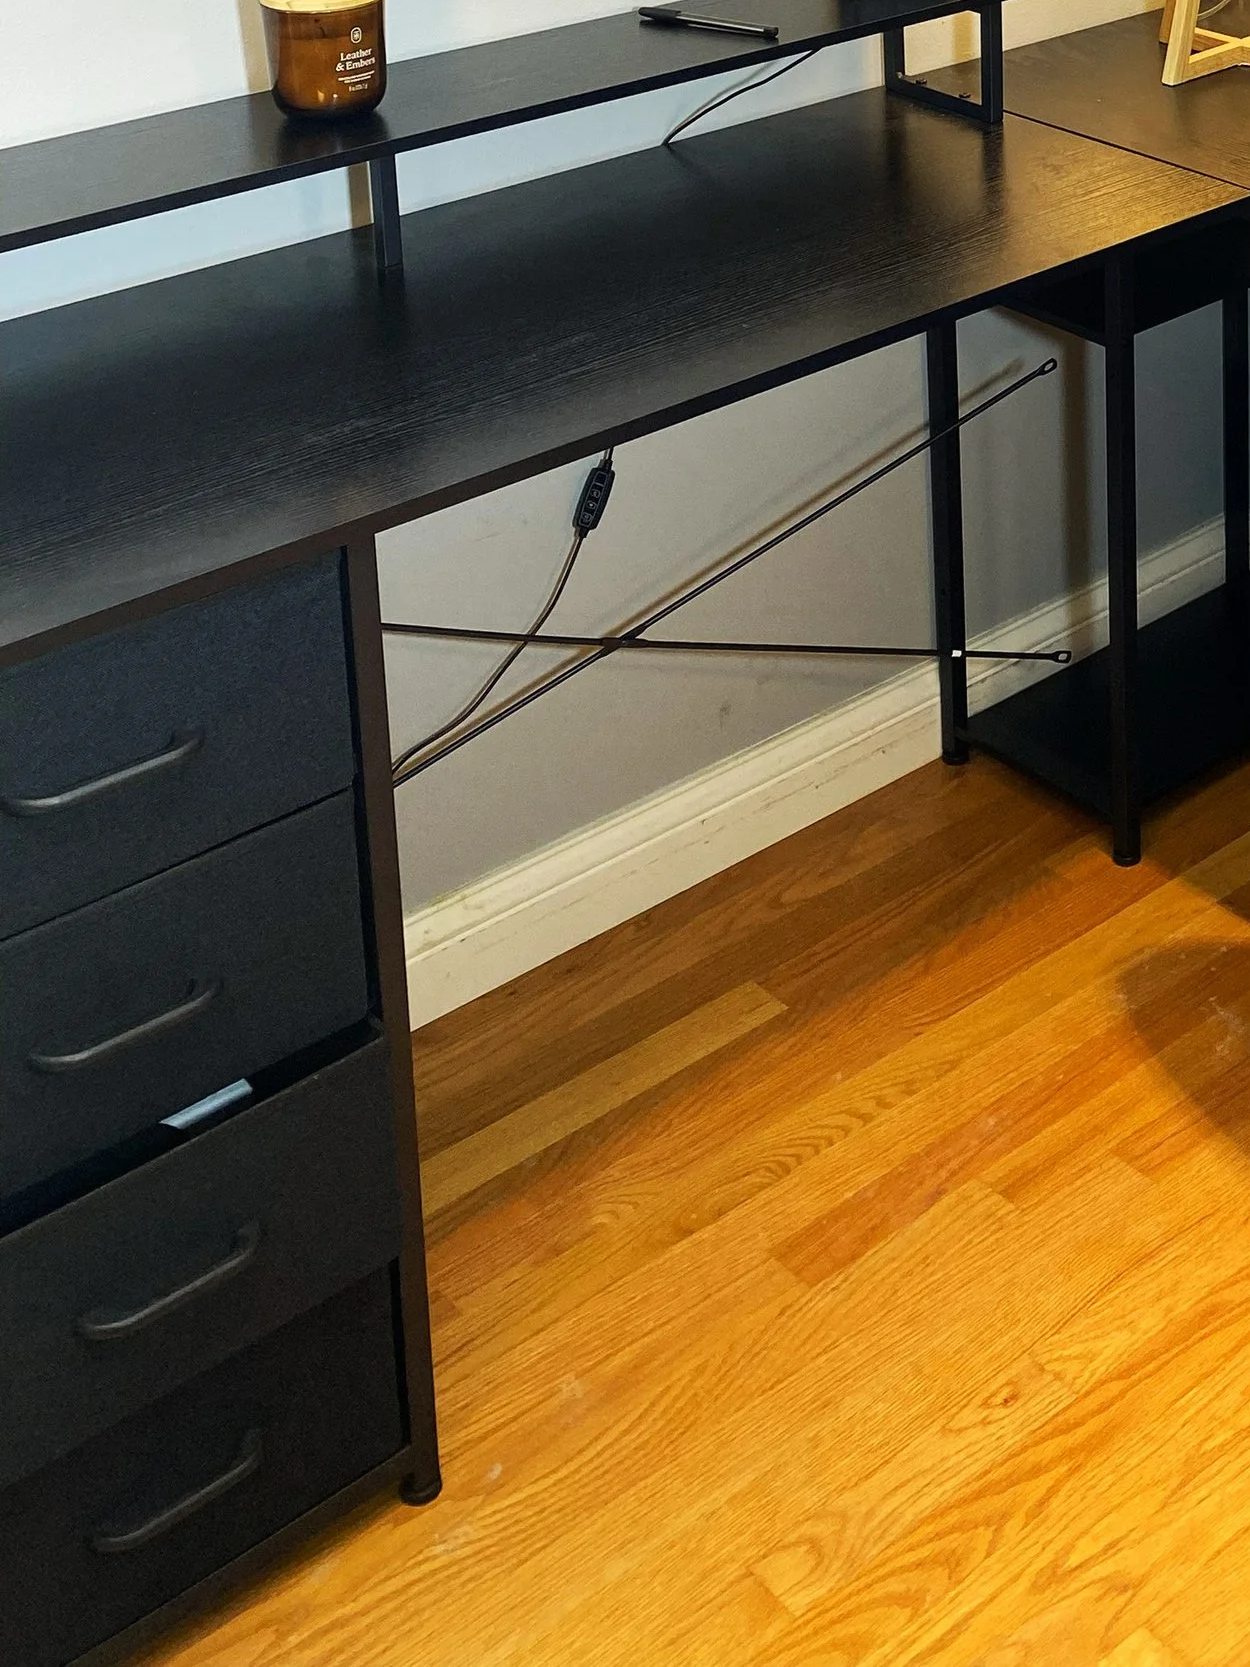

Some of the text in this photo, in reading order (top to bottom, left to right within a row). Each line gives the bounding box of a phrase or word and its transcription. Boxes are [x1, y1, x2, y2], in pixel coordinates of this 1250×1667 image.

[340, 49, 372, 61] Leather
[335, 57, 376, 72] & Embers
